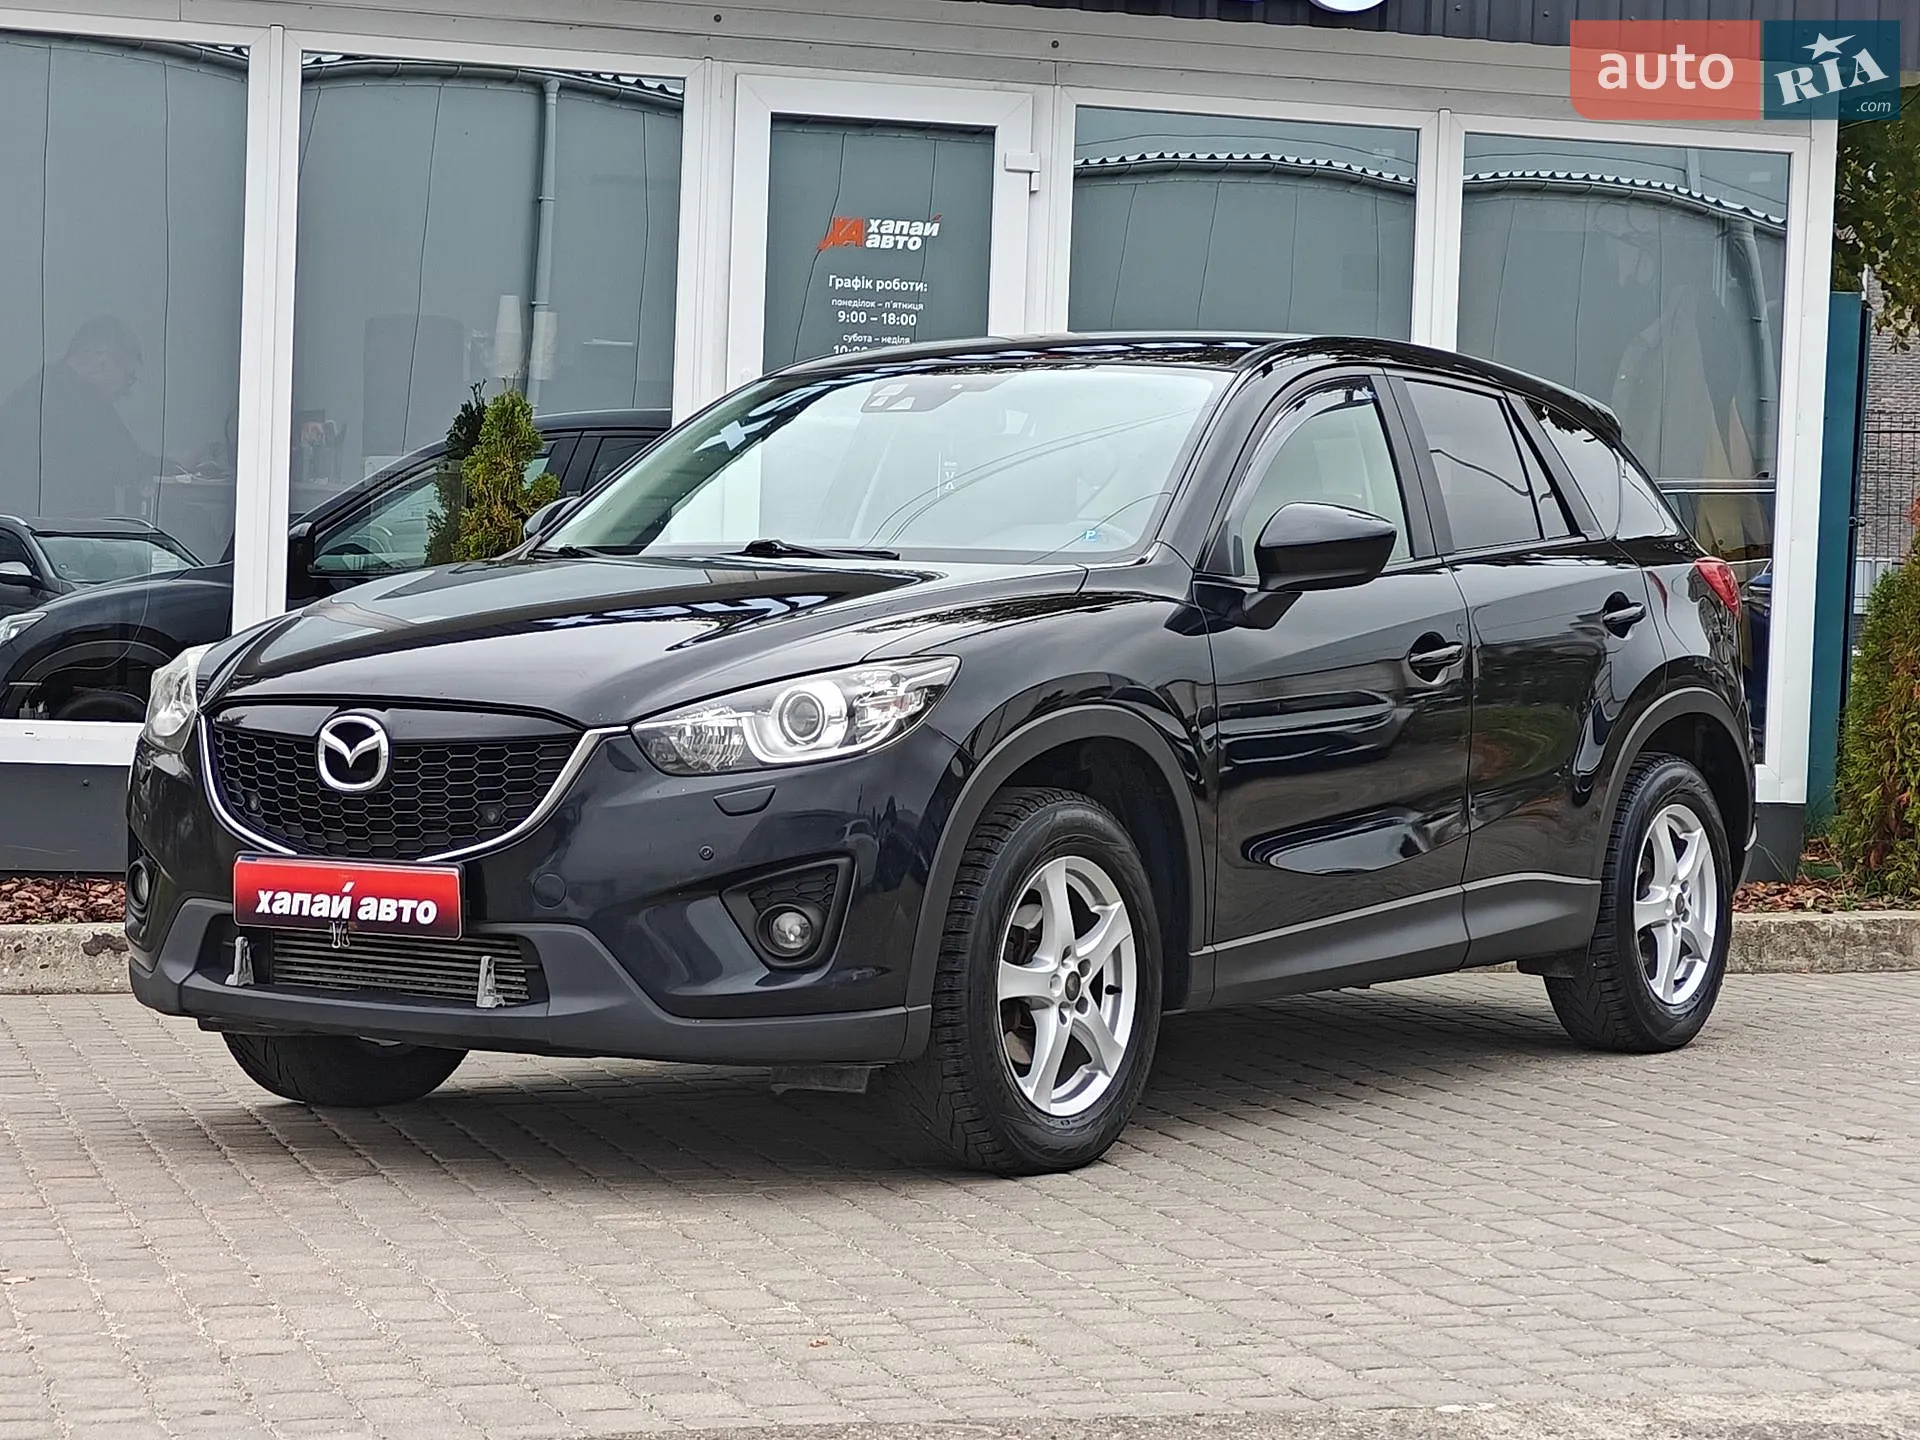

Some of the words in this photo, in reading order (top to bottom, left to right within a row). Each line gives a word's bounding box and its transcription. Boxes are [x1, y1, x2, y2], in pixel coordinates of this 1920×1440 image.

[865, 233, 923, 251] авто
[828, 274, 874, 291] Графік
[875, 278, 929, 293] роботи:
[831, 298, 876, 308] понеділок
[837, 310, 868, 324] 9:00
[881, 312, 918, 327] 18:00
[842, 332, 873, 344] субота
[881, 334, 911, 345] неділя
[255, 881, 355, 920] хапай
[357, 896, 438, 925] авто
